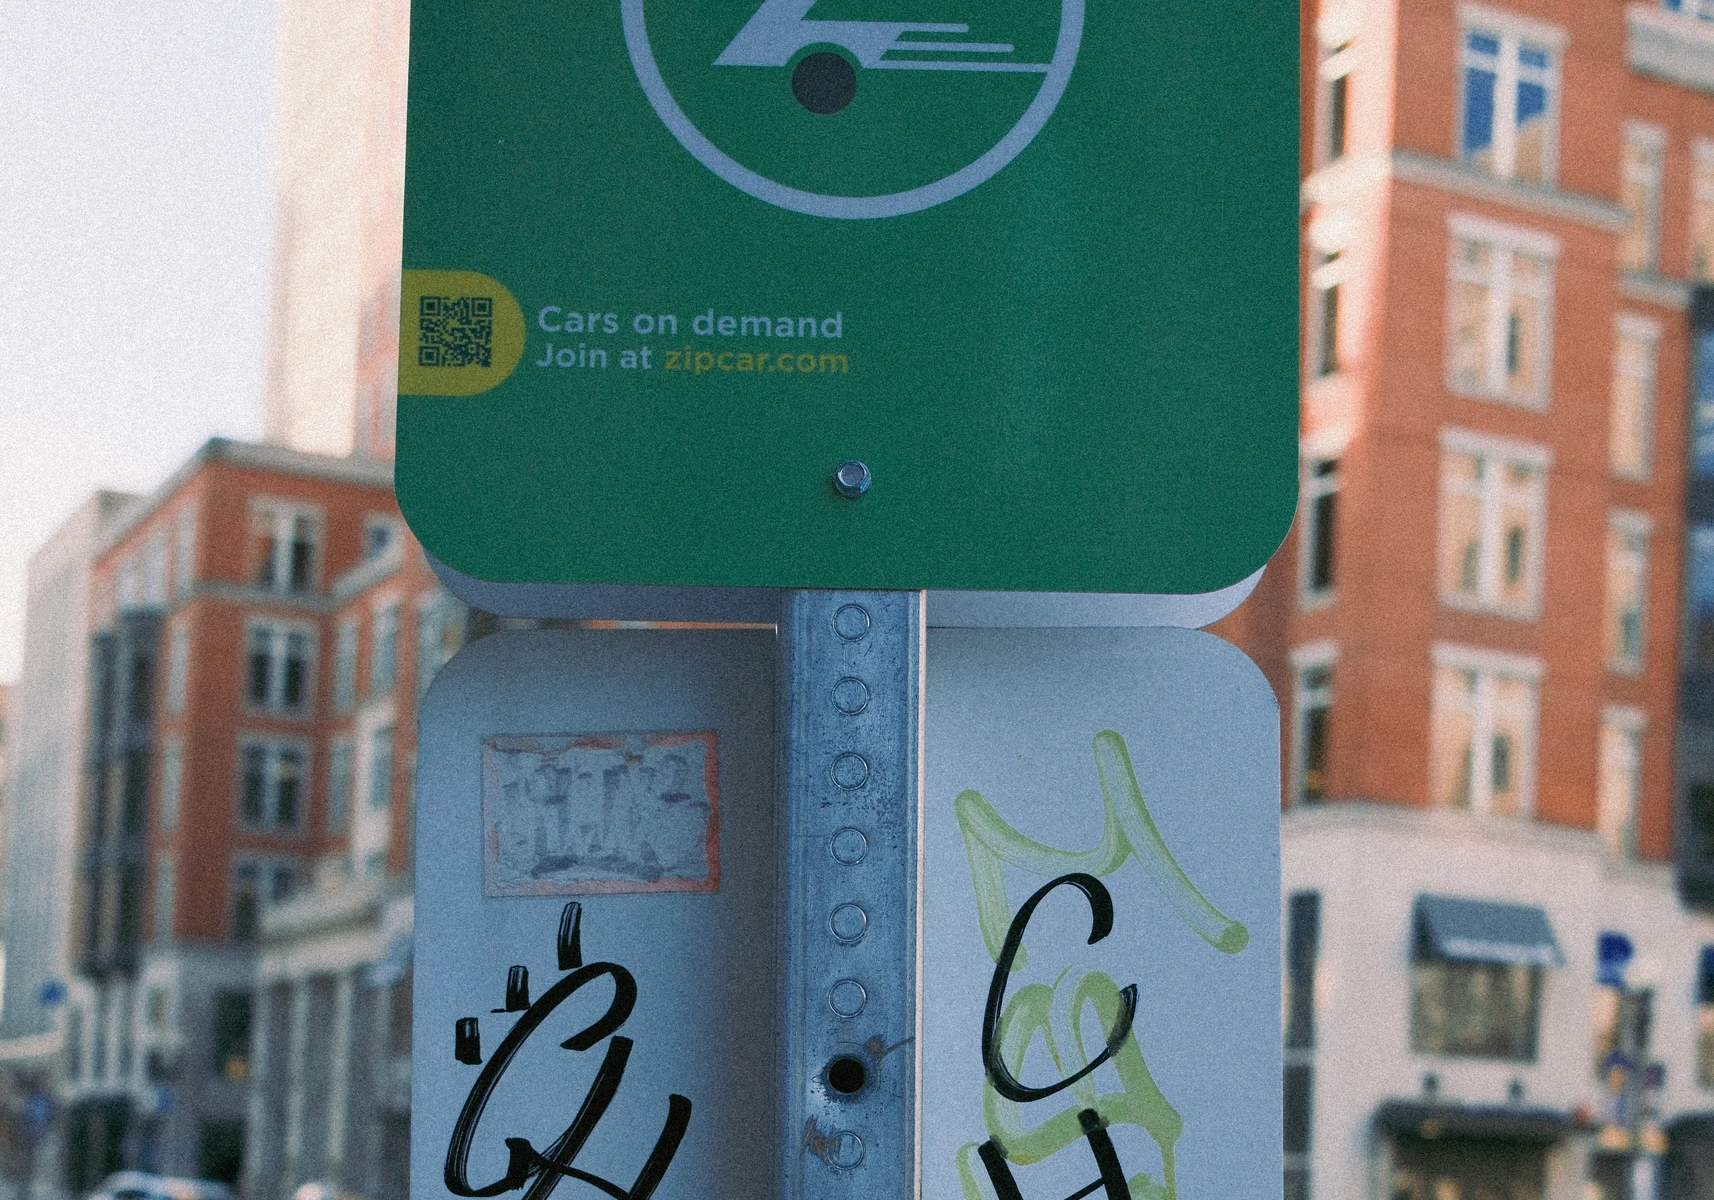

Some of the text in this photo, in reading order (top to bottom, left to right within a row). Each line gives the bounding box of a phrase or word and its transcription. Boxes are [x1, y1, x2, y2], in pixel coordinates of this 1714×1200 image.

[537, 305, 844, 339] Cars on demand
[535, 343, 850, 376] Join at zipcar.com
